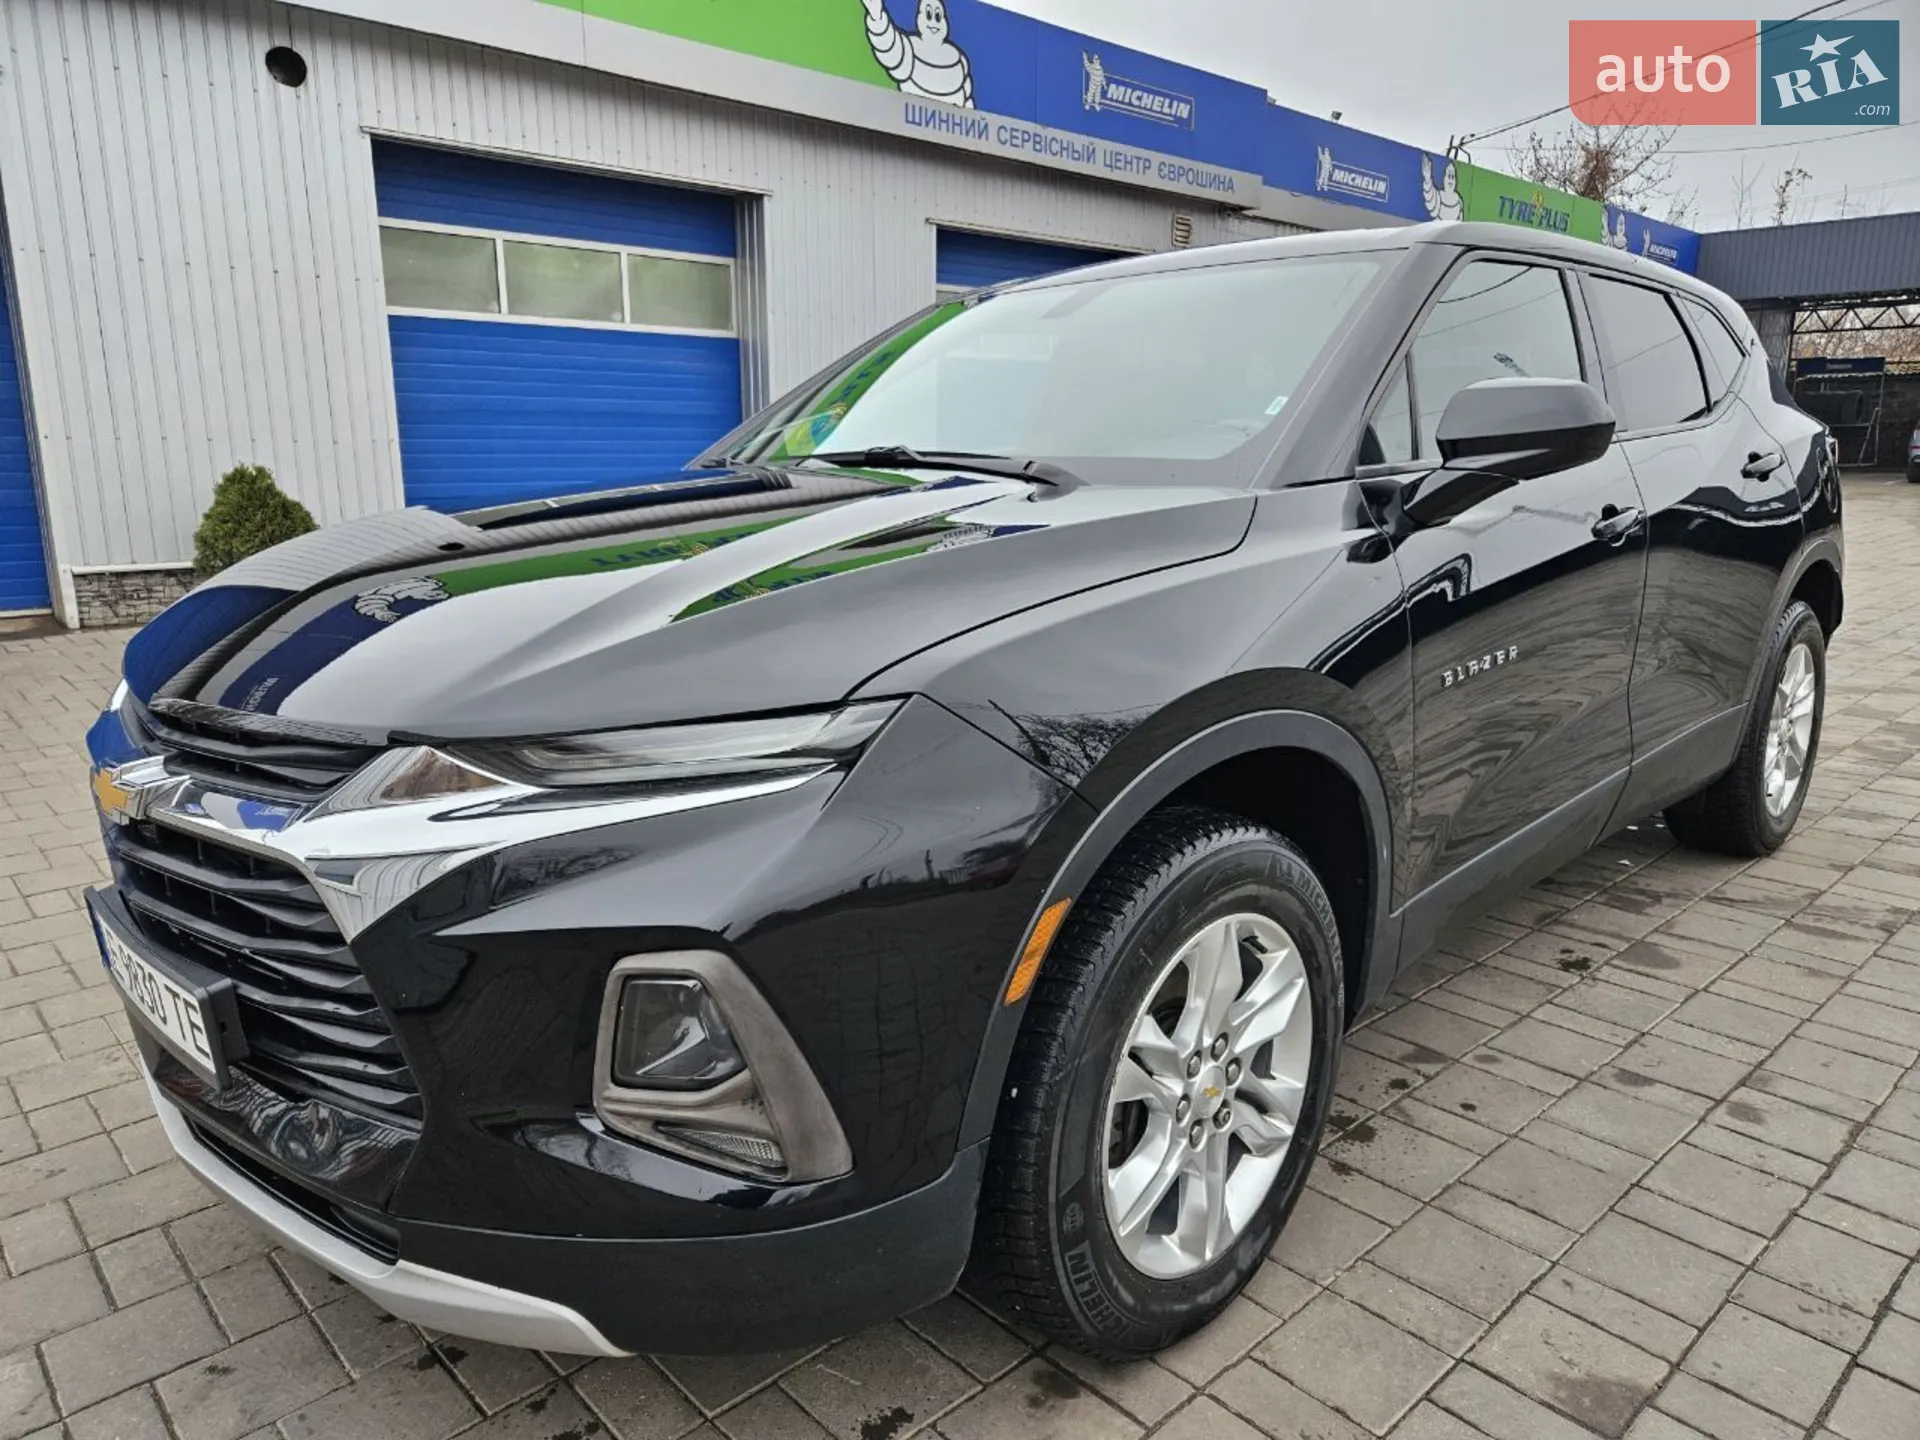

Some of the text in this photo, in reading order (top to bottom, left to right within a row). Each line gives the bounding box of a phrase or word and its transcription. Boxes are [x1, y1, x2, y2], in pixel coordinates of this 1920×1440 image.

[1106, 83, 1191, 119] MICHELIN
[905, 102, 1235, 194] ШИННИЙ СЕРВІСНЫЙ ЦЕНТР ЄВРОШИНА
[1332, 168, 1387, 193] MICHELIN
[1442, 645, 1518, 688] BLAZER
[164, 982, 212, 1061] TE
